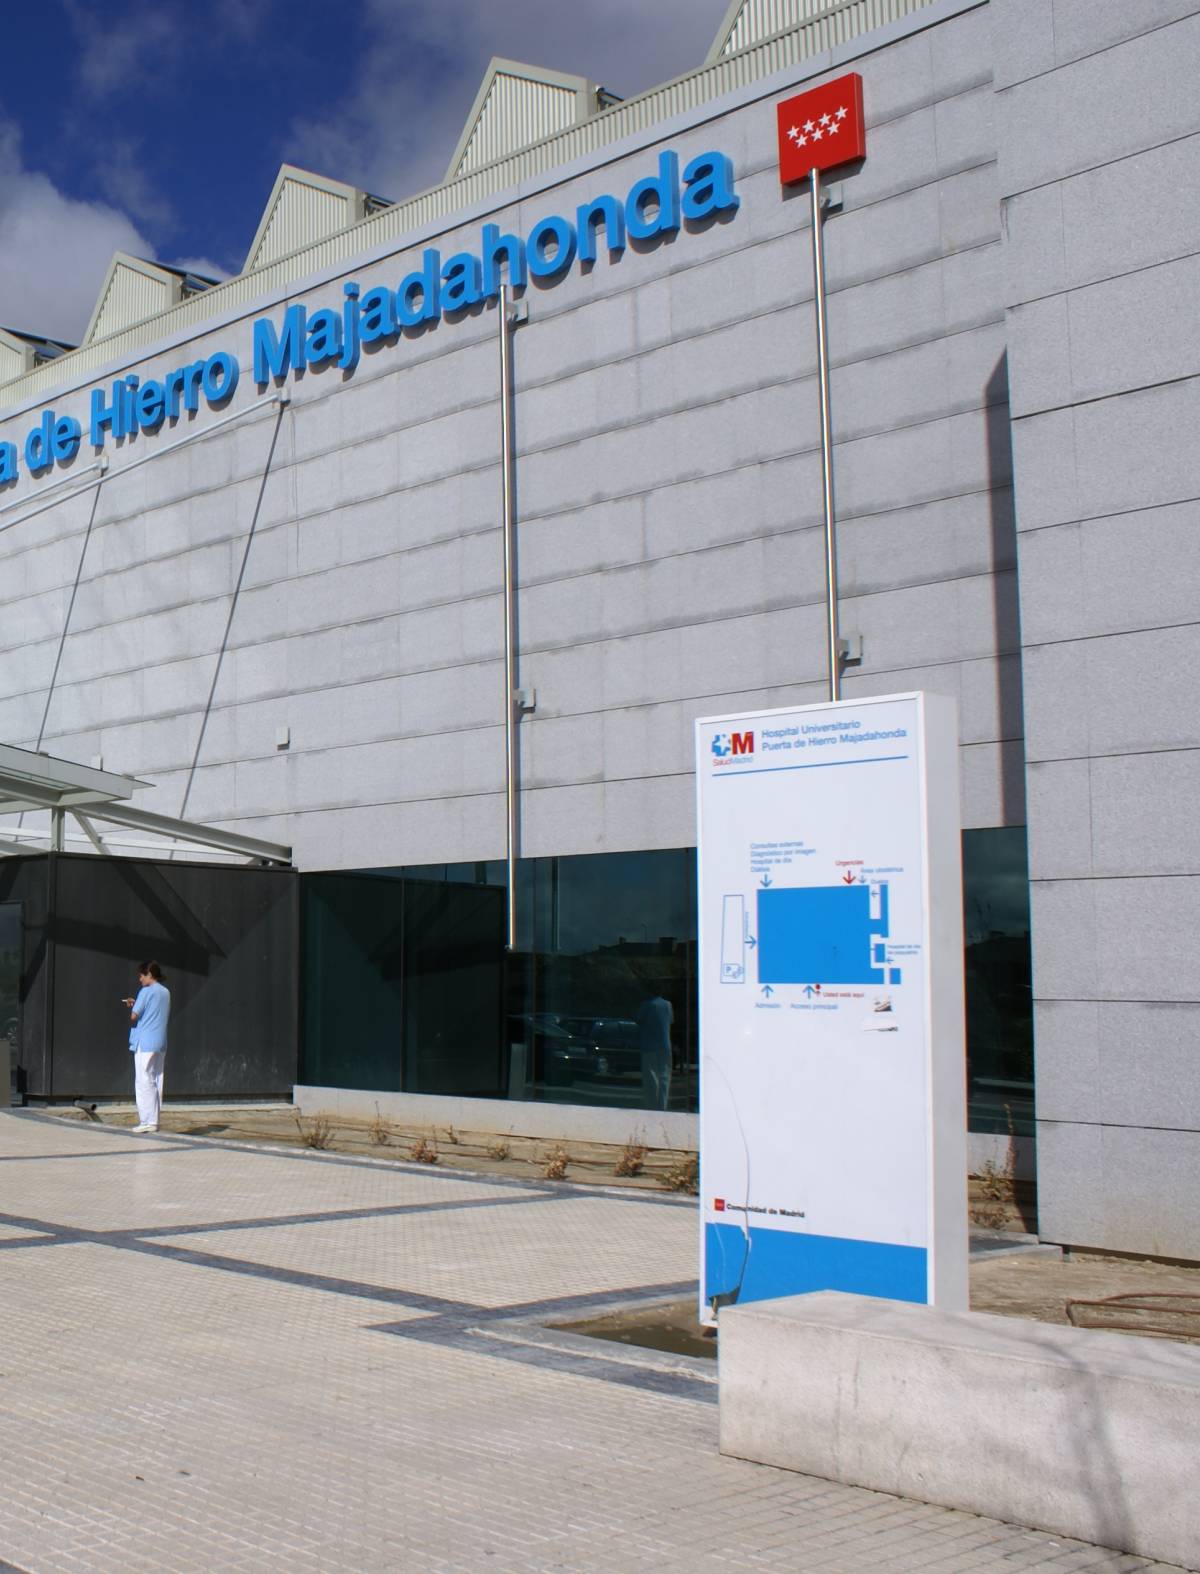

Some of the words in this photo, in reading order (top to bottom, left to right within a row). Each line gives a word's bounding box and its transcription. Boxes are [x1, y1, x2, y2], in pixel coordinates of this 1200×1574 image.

[25, 410, 81, 470] de
[90, 352, 239, 446] Hierro
[253, 149, 740, 385] Majadahonda
[761, 726, 799, 739] Hospital
[801, 720, 861, 734] Universitario
[761, 740, 792, 751] Puerta
[794, 738, 806, 748] de
[808, 735, 837, 747] Hierro
[840, 729, 907, 744] Majadahonda
[727, 1203, 767, 1214] Comunidad
[768, 1207, 778, 1215] de
[779, 1208, 805, 1218] Madrid
